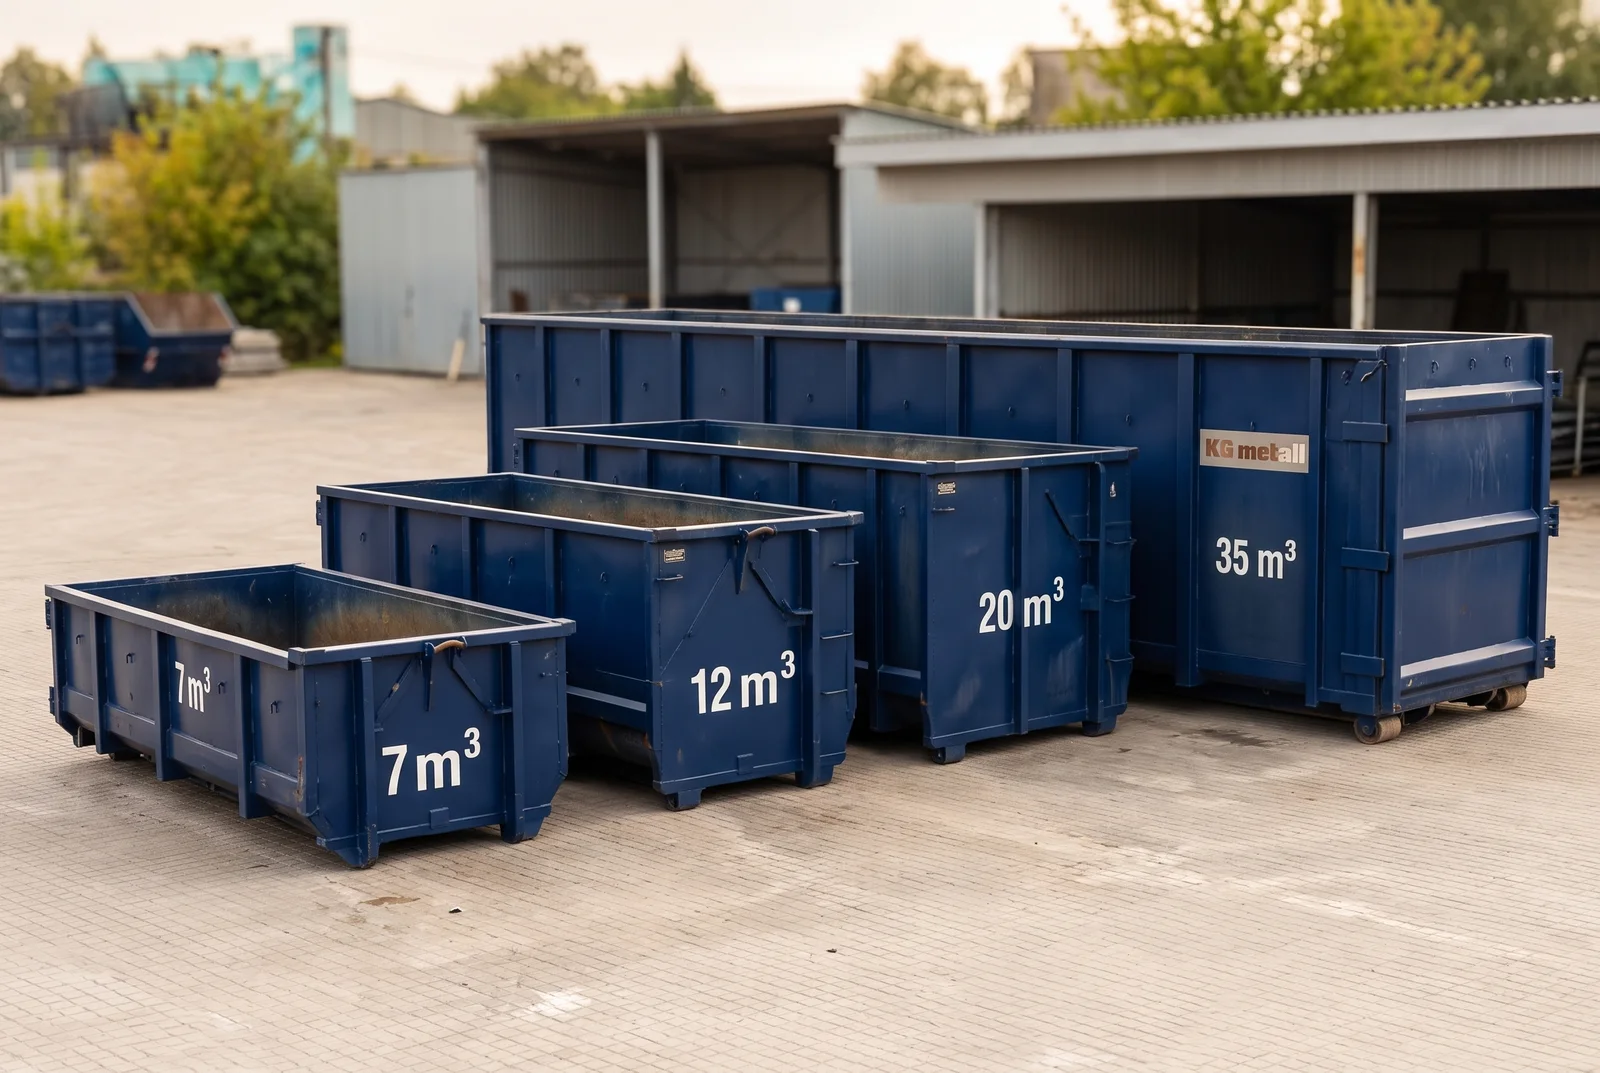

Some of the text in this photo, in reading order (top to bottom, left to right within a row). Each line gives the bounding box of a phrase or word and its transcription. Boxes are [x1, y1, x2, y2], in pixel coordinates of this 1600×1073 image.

[1205, 438, 1306, 464] KG metall
[1215, 536, 1249, 576] 35
[978, 589, 1014, 634] 20
[690, 666, 732, 715] 12
[381, 743, 408, 797] 7
